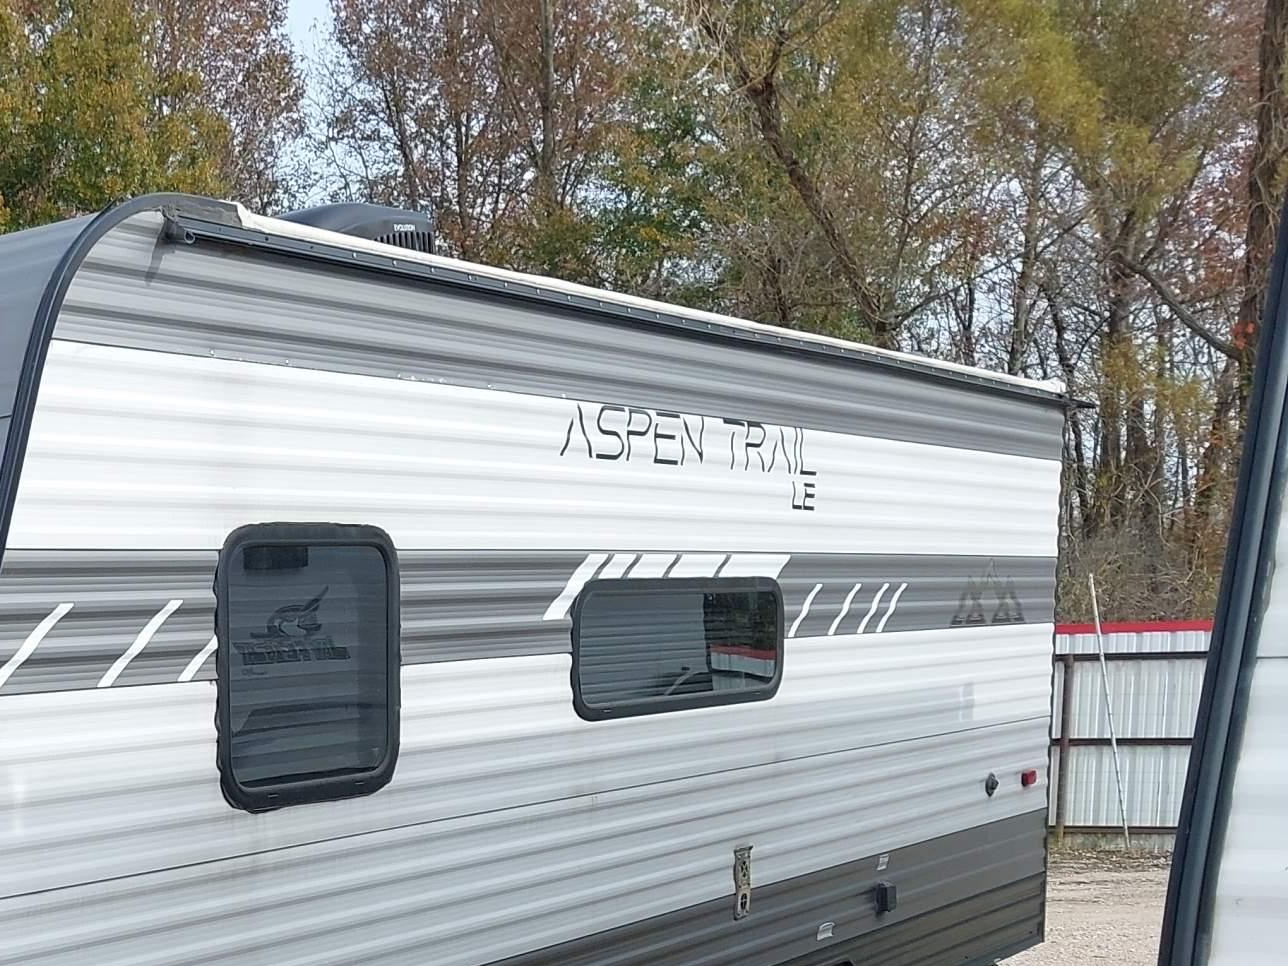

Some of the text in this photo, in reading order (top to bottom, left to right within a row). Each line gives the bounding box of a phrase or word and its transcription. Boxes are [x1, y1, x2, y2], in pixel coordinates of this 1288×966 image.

[559, 402, 817, 476] ASPEN TRAIL
[791, 480, 816, 511] LE
